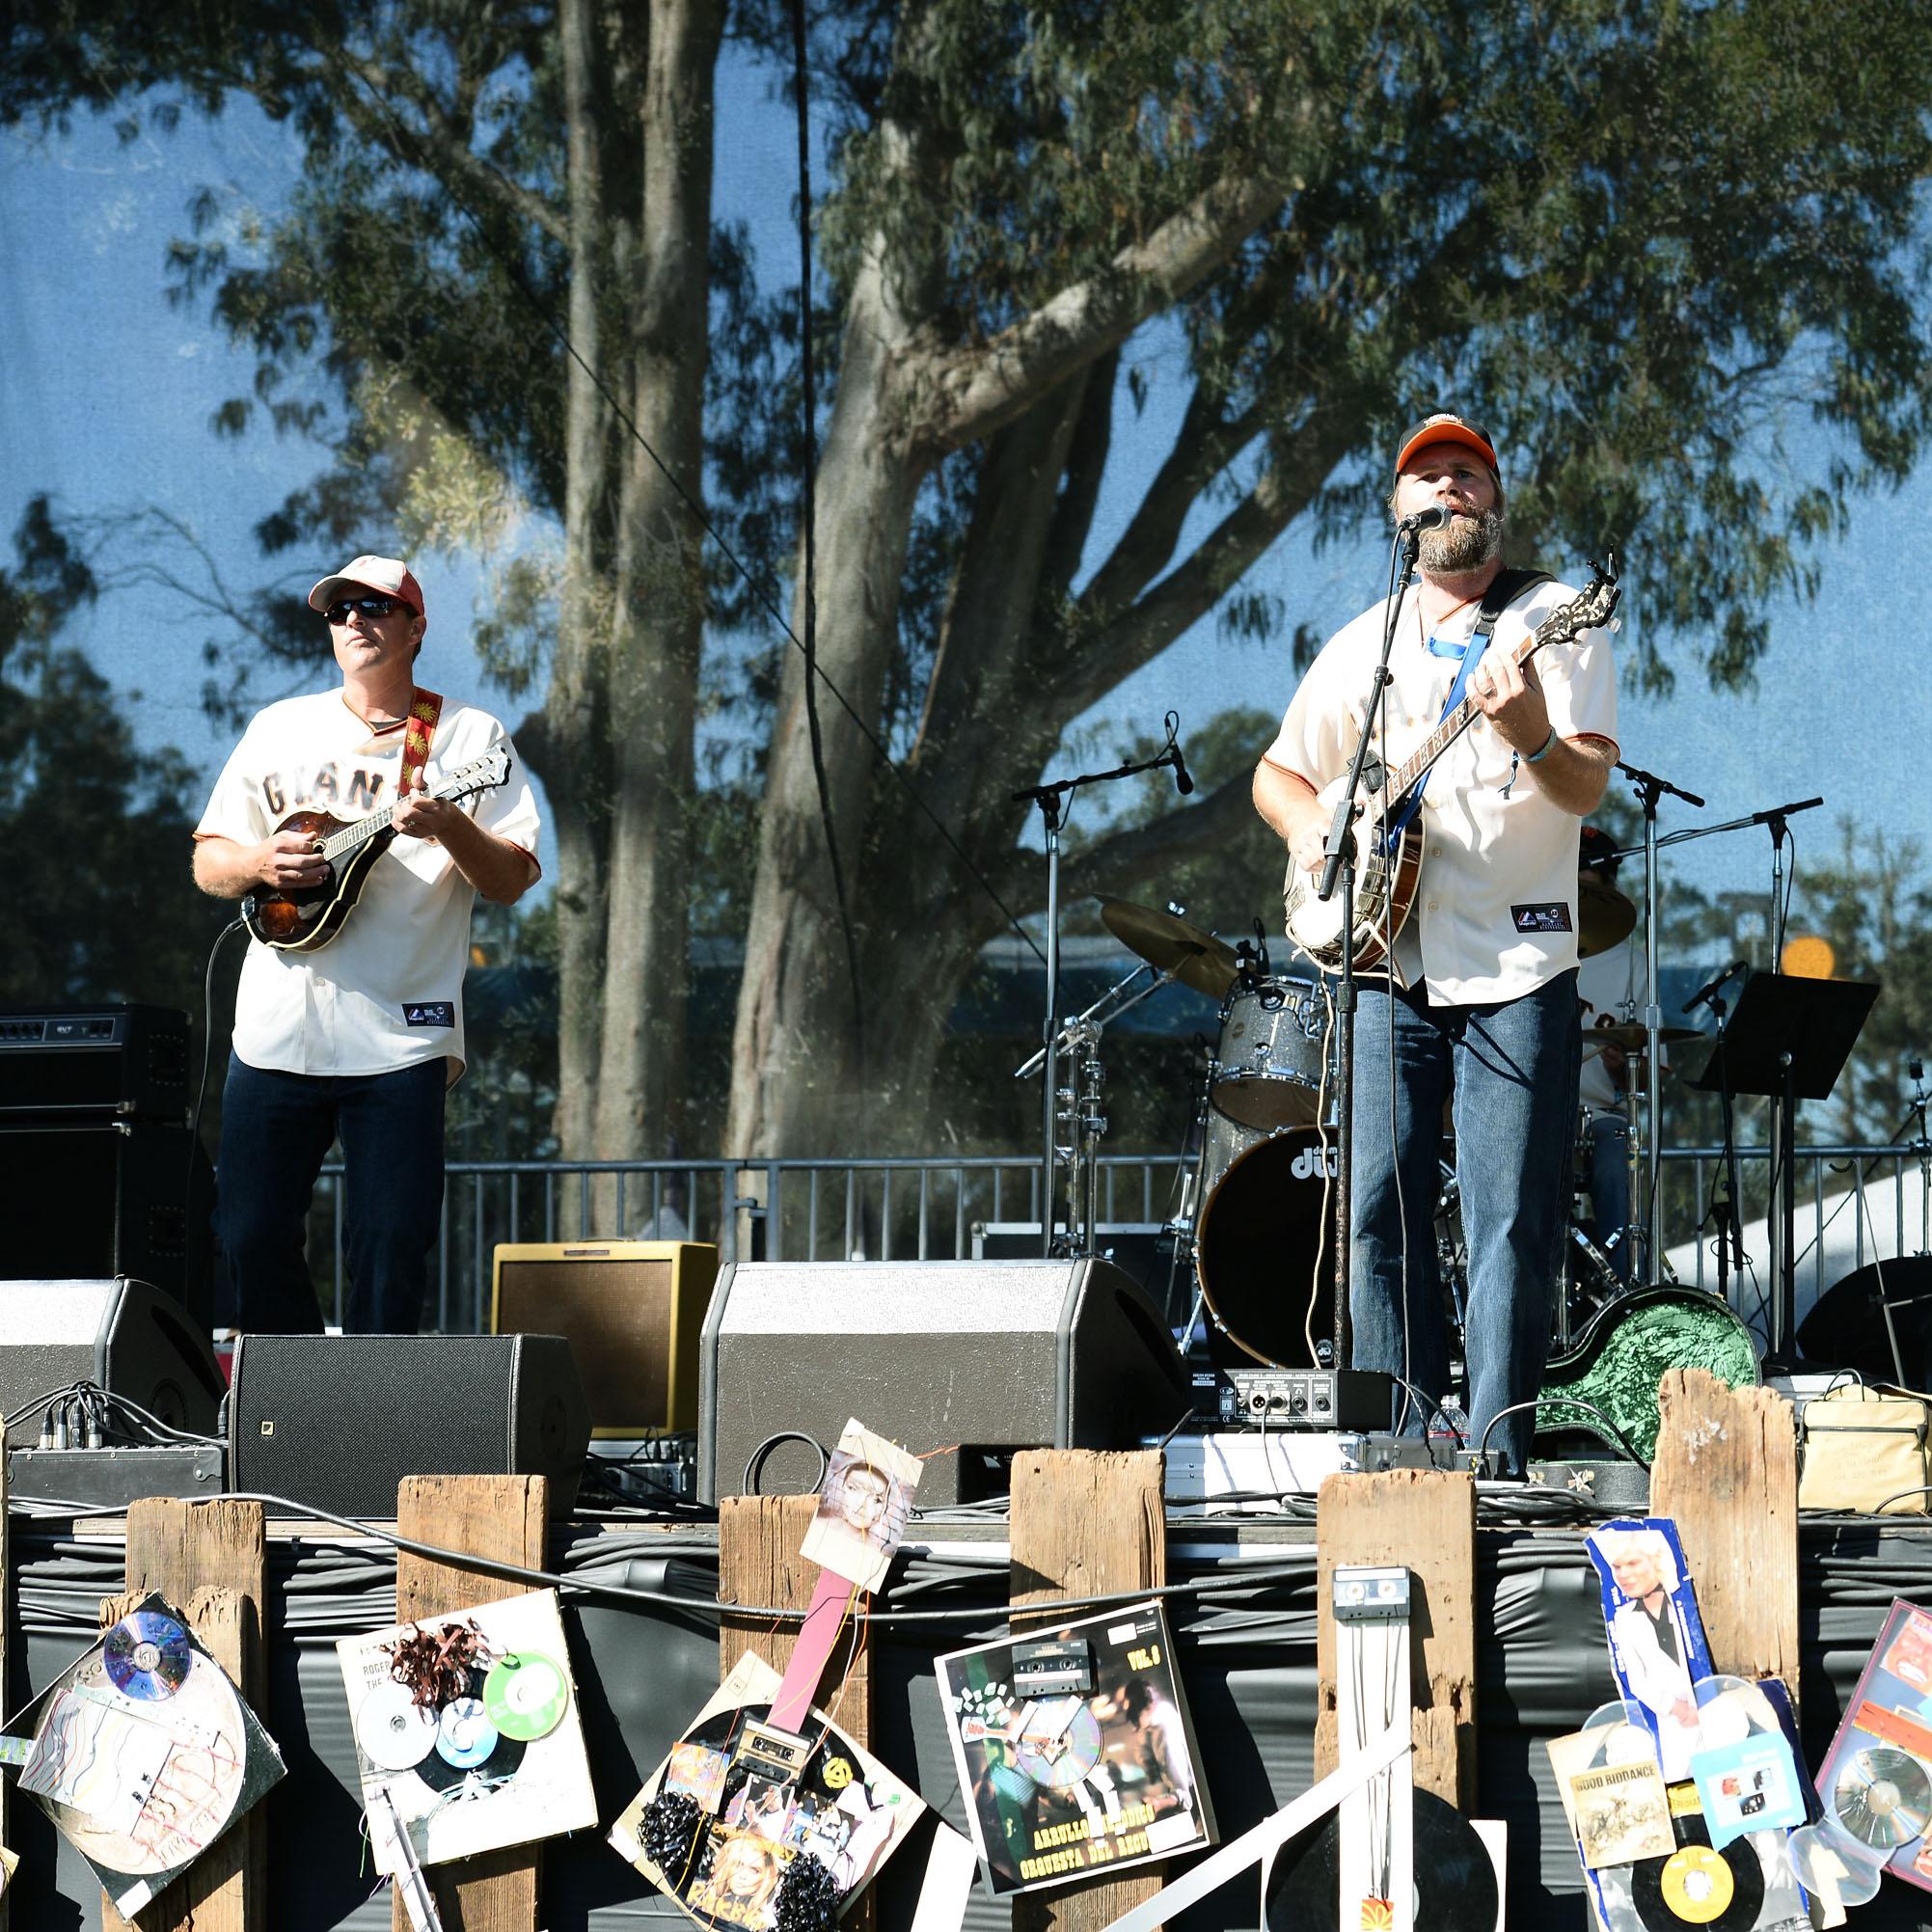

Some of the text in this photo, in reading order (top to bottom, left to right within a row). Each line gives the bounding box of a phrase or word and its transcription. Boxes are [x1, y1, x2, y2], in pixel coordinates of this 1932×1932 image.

[261, 761, 396, 815] GIAN
[363, 1660, 392, 1675] ROGER
[1575, 1764, 1655, 1792] GOOD RIDDANCE
[1033, 1818, 1090, 1851] ARRULLO
[1020, 1846, 1085, 1880] ORQUESTA
[1116, 1831, 1149, 1858] RECU
